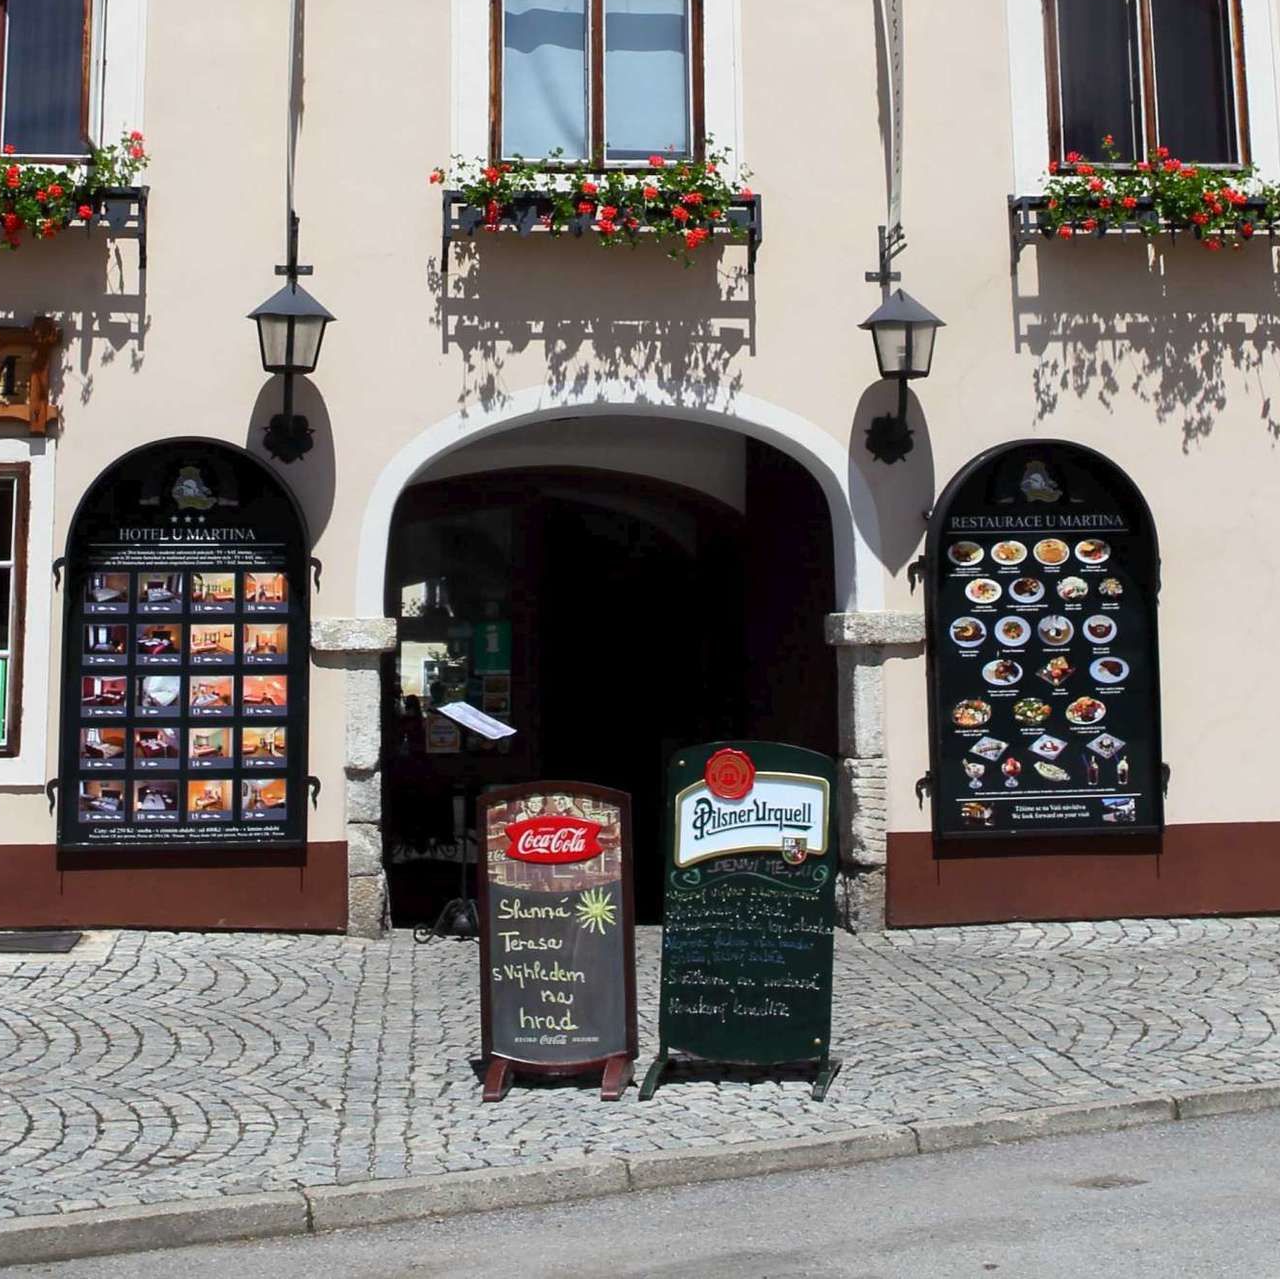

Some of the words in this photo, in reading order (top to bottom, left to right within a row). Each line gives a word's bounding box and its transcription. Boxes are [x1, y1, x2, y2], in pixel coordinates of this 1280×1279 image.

[952, 515, 1042, 529] RESTAURACE
[1046, 515, 1056, 527] U
[1059, 514, 1124, 527] MARTINA
[120, 528, 169, 541] HOTEL
[172, 528, 184, 540] U
[186, 528, 256, 541] MARTINA
[692, 797, 755, 841] Pilsner
[753, 799, 812, 831] Urquell
[518, 827, 587, 854] Coca-Cola
[498, 897, 571, 920] Slunná
[497, 931, 563, 953] Terasa
[492, 967, 502, 982] s
[541, 989, 574, 1004] na
[519, 1007, 578, 1031] hrad
